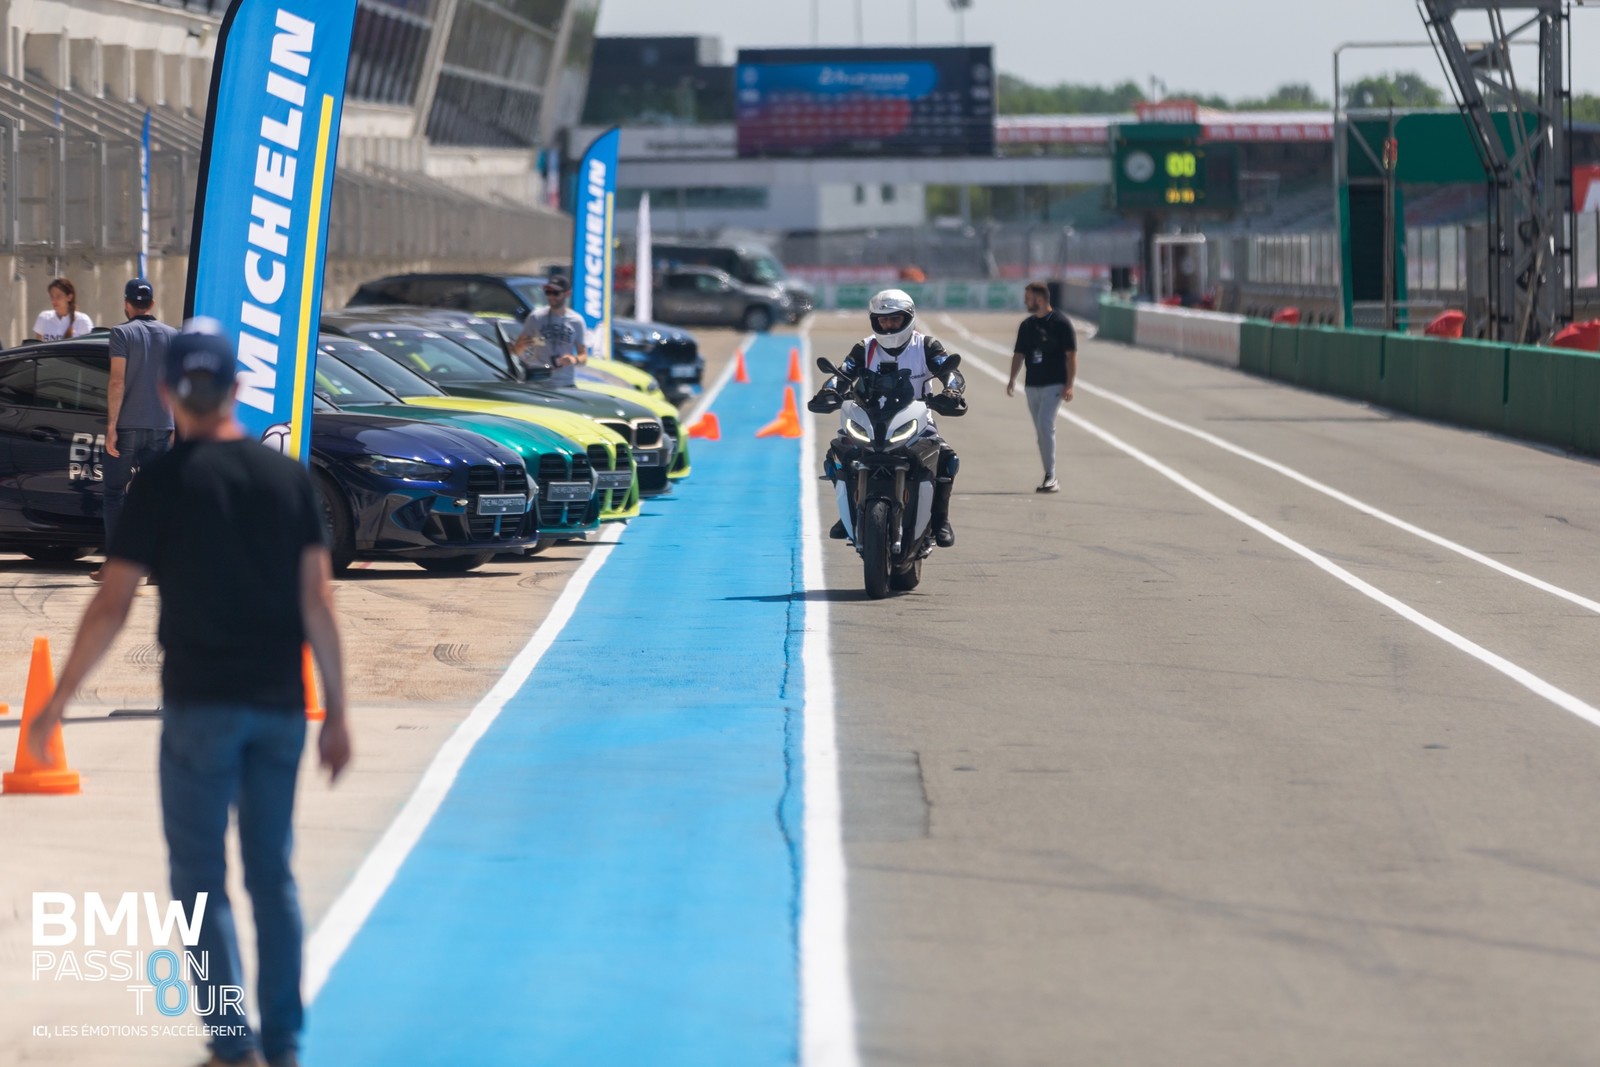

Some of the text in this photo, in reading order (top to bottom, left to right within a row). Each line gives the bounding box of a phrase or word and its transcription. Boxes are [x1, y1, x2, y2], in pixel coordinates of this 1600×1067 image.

[234, 8, 315, 414] MICHELIN
[584, 158, 607, 319] MICHELIN
[481, 498, 492, 507] THE
[498, 498, 525, 506] COMPETITION
